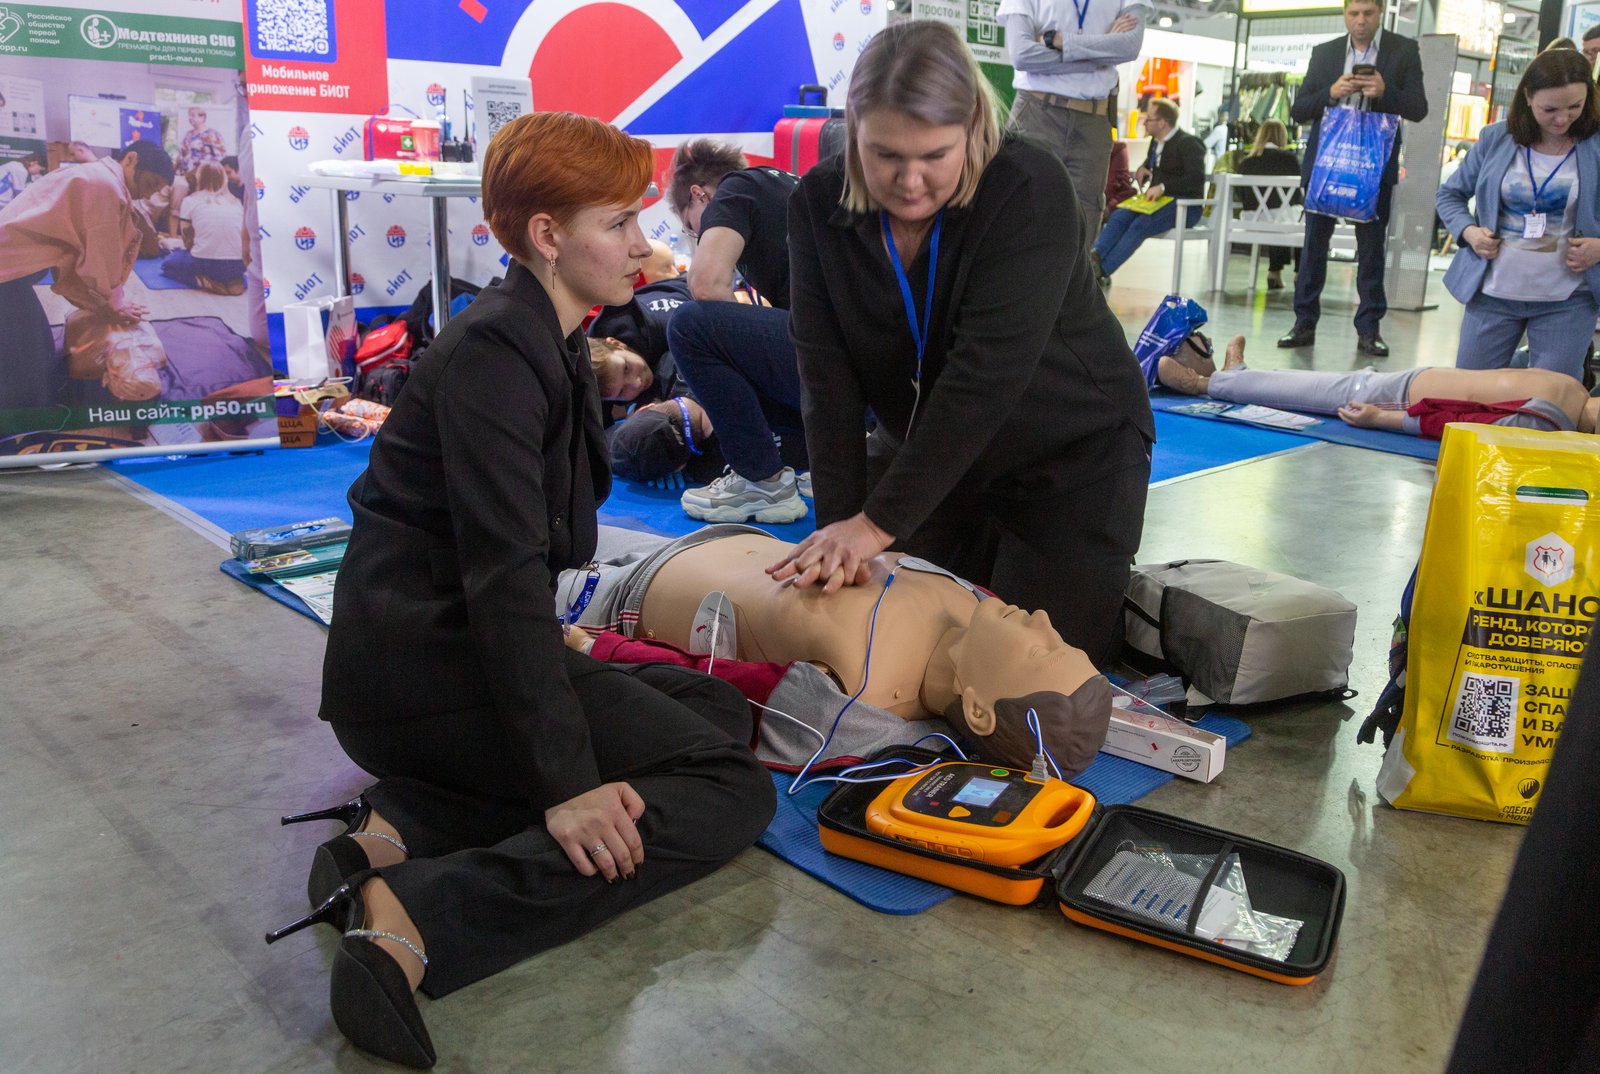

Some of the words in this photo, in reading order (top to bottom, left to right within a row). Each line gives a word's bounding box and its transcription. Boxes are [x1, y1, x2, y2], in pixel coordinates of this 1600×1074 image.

[27, 12, 72, 21] Российское
[28, 21, 65, 29] общество
[117, 28, 207, 45] Медтехника
[209, 34, 236, 48] СПб
[149, 54, 204, 63] practi-man.ru
[262, 64, 330, 81] Мобильное
[319, 84, 351, 98] БИОТ
[88, 407, 131, 422] Наш
[136, 404, 187, 420] сайт:
[190, 400, 267, 419] pp50.ru
[1522, 717, 1537, 731] И
[1521, 733, 1557, 749] УМ
[1450, 744, 1500, 762] РАЗРАБОТКА
